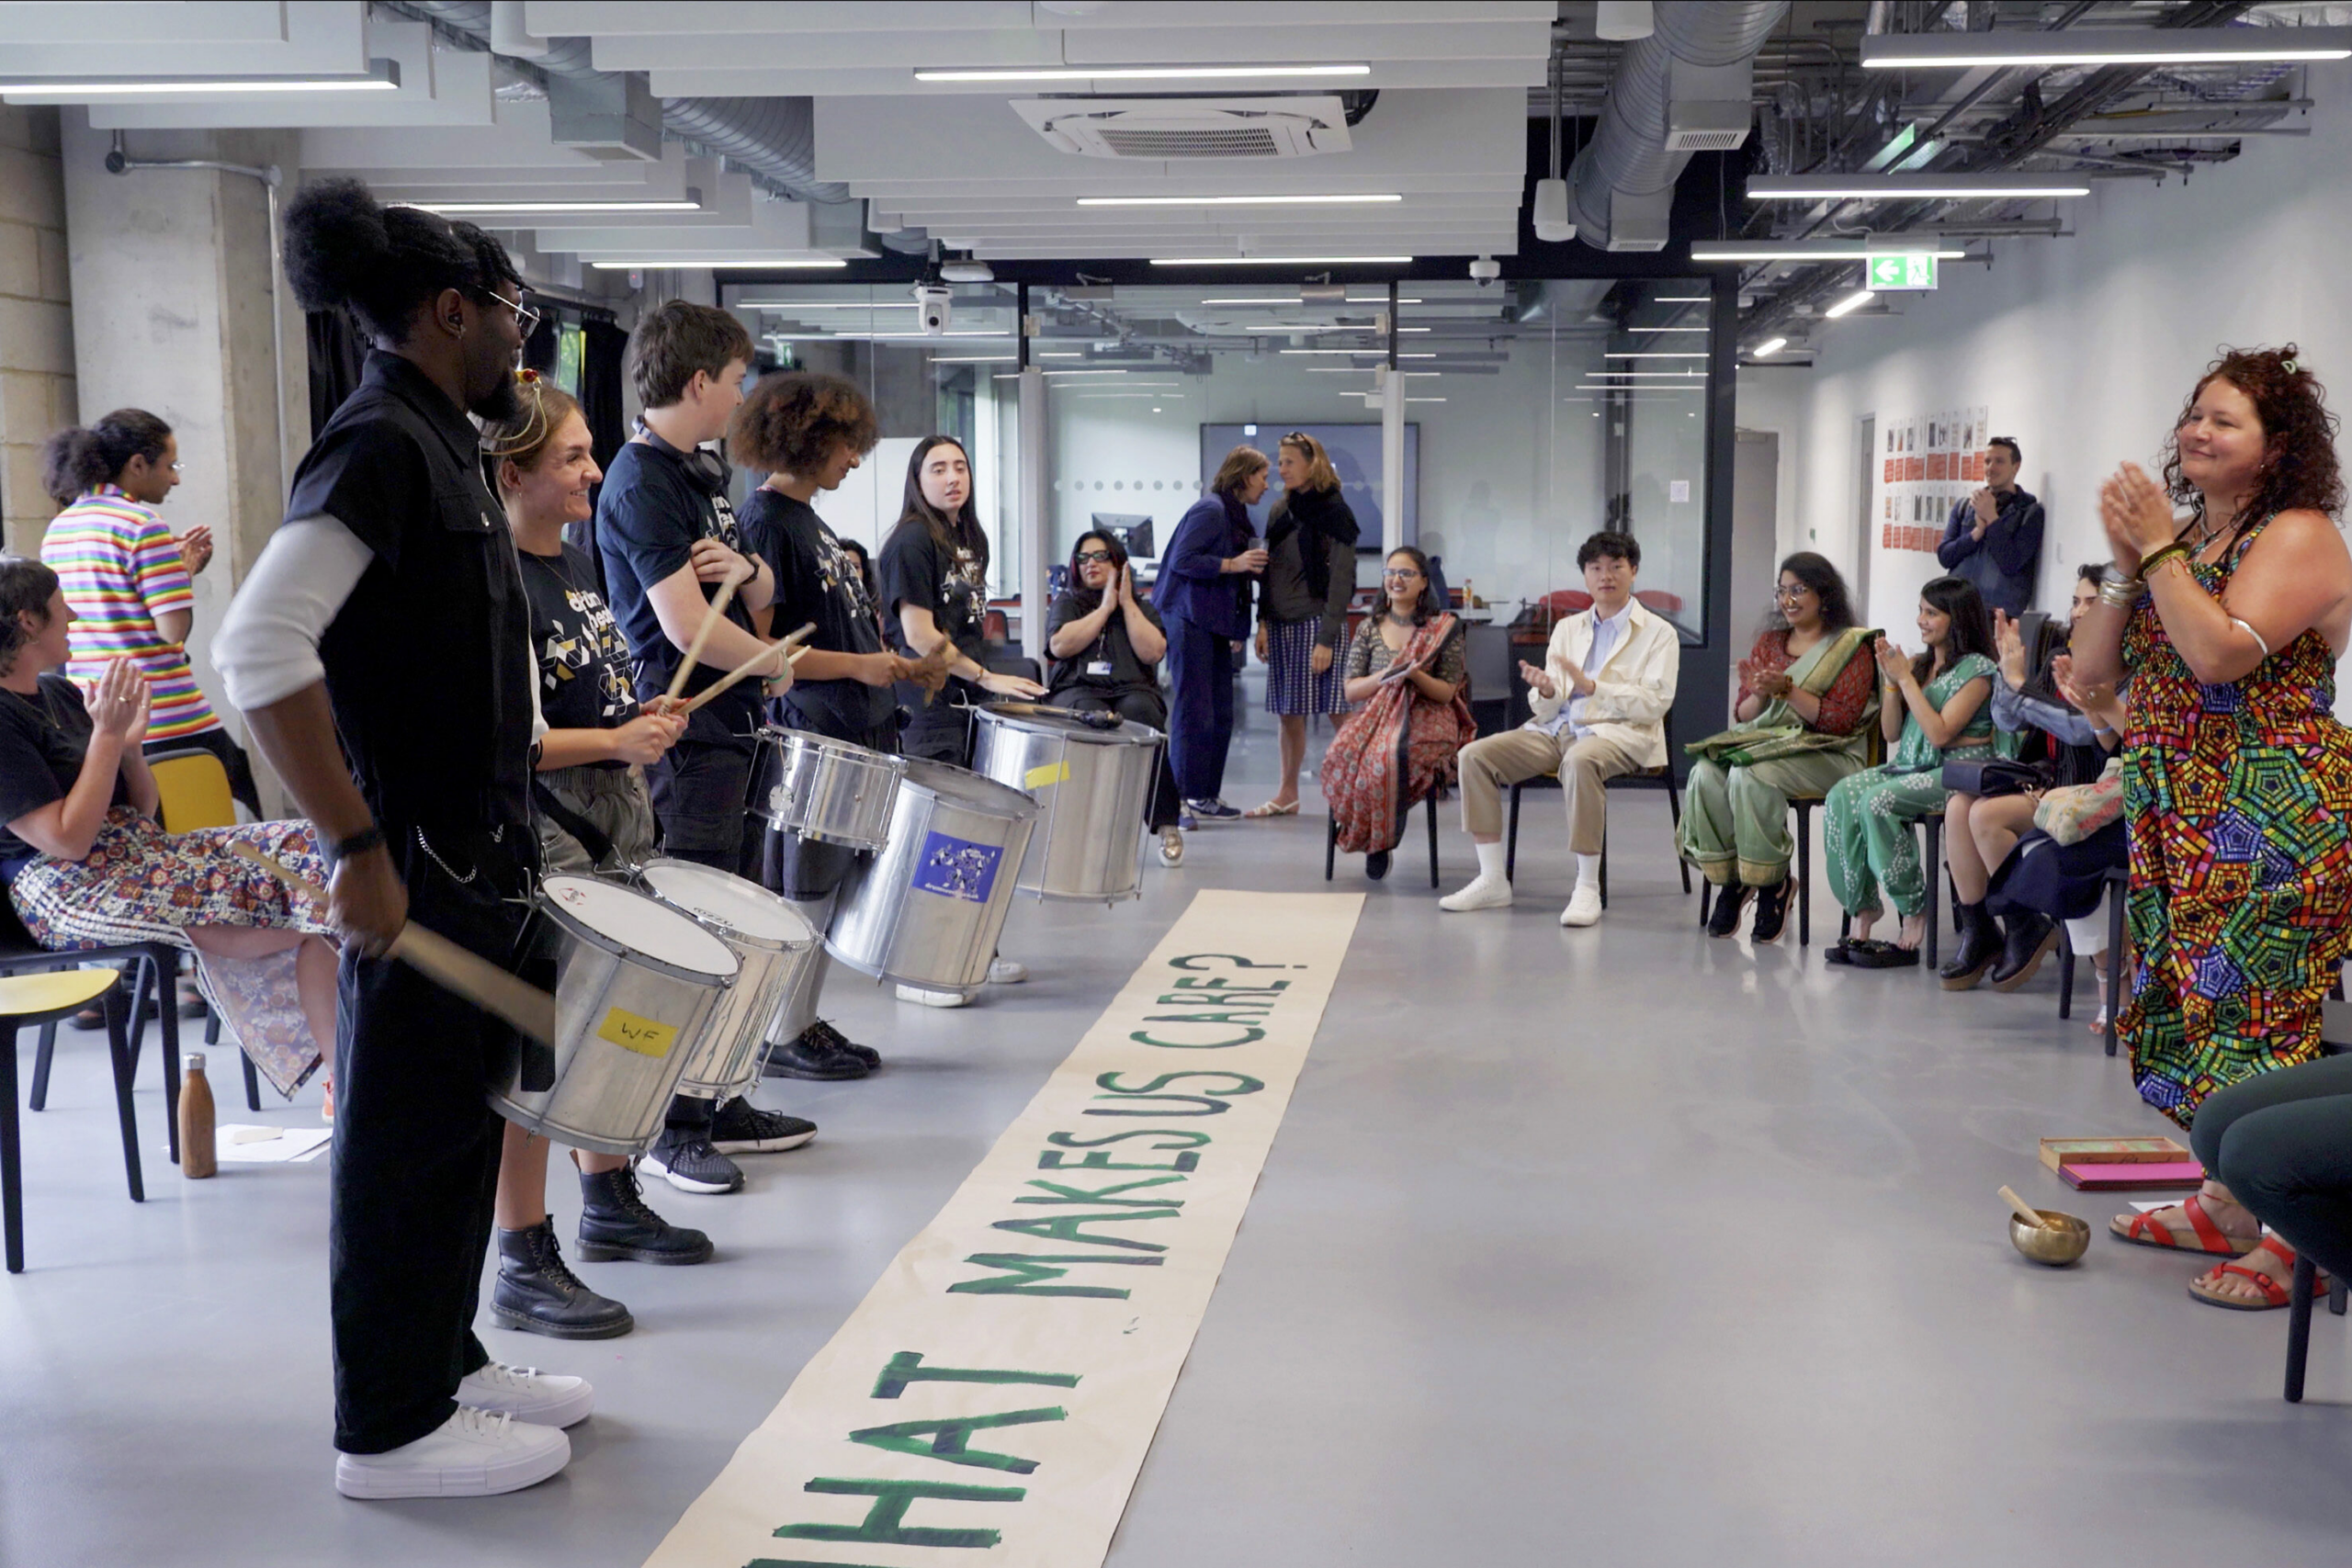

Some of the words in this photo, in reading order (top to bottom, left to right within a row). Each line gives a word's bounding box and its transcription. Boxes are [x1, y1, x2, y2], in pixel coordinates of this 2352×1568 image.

[621, 1021, 660, 1040] WF
[1129, 953, 1308, 1049] CARE?
[1081, 1070, 1265, 1116] US
[946, 1130, 1212, 1300] MAKES
[741, 1351, 1084, 1568] HAT
